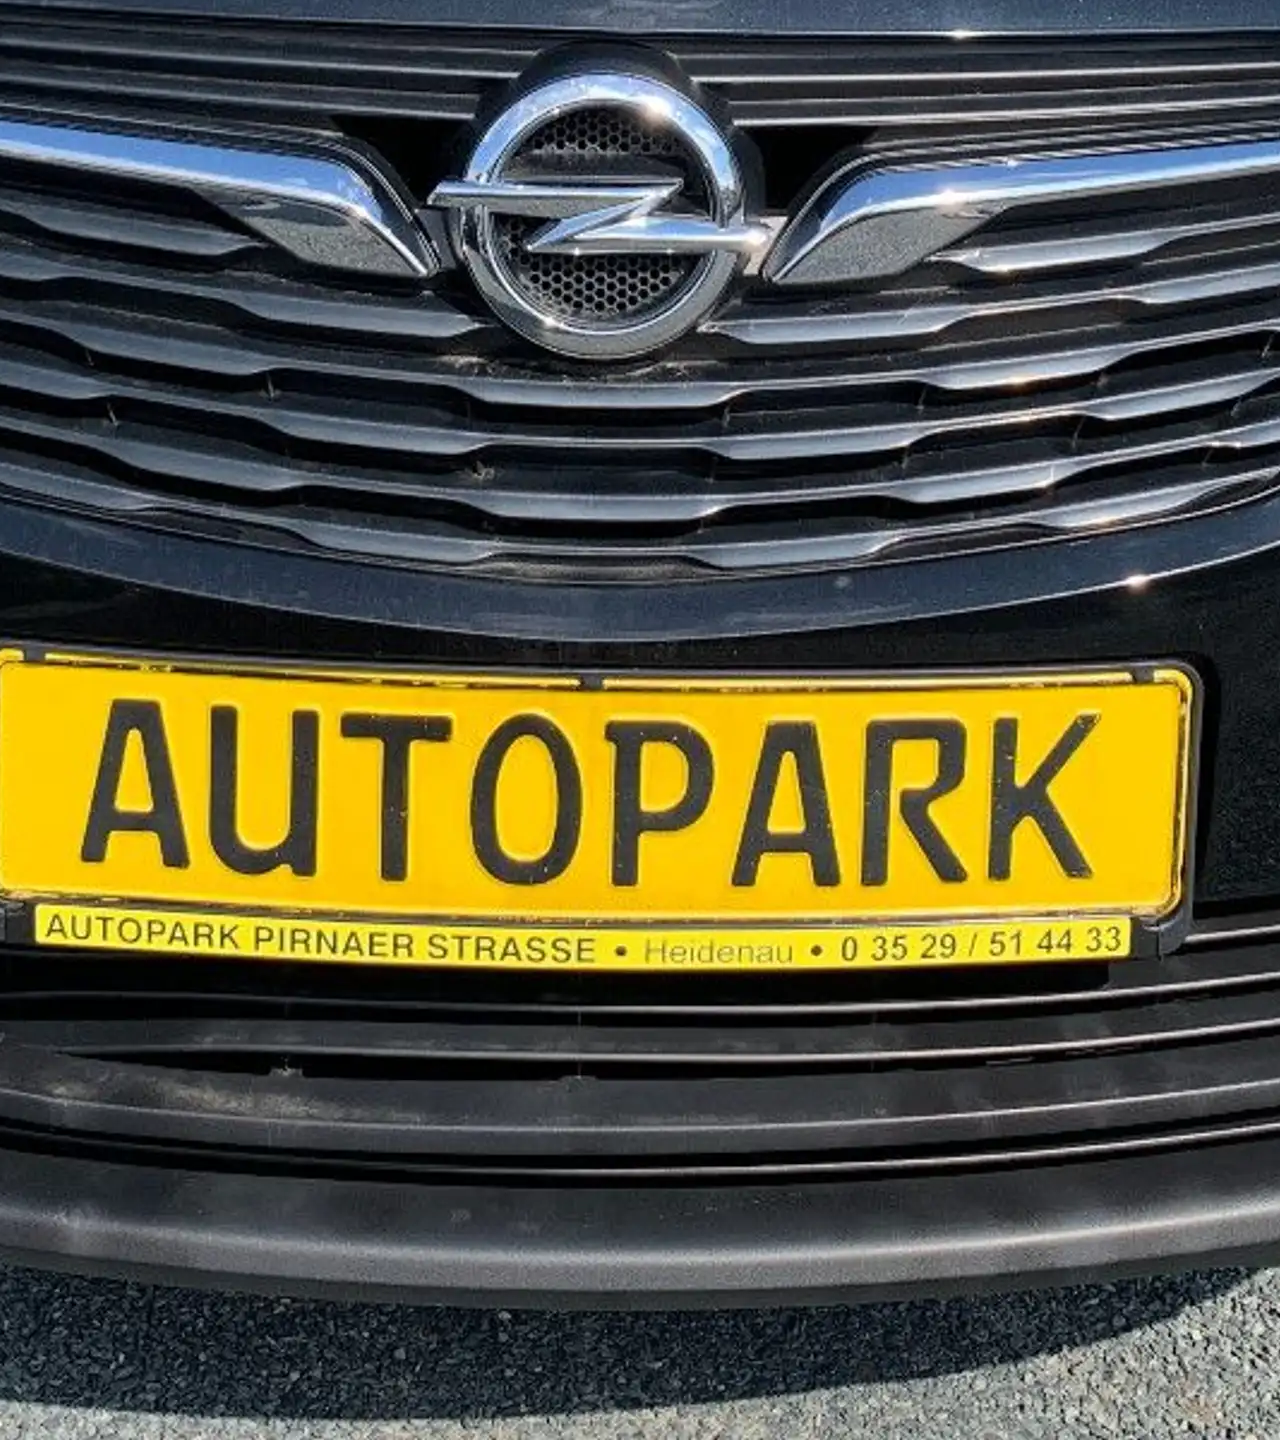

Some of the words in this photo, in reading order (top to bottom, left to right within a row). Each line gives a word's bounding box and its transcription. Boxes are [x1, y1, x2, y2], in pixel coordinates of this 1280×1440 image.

[80, 697, 1102, 888] AUTOPARK
[45, 913, 240, 950] AUTOPARK
[253, 925, 415, 958] PIRNAER
[427, 933, 596, 963] STRASSE
[644, 937, 793, 965] Heidenau
[840, 936, 858, 962] 0
[871, 934, 908, 961] 35
[920, 933, 957, 960] 29
[988, 929, 1023, 957] 51
[1036, 928, 1072, 954] 44
[1085, 925, 1122, 953] 33
